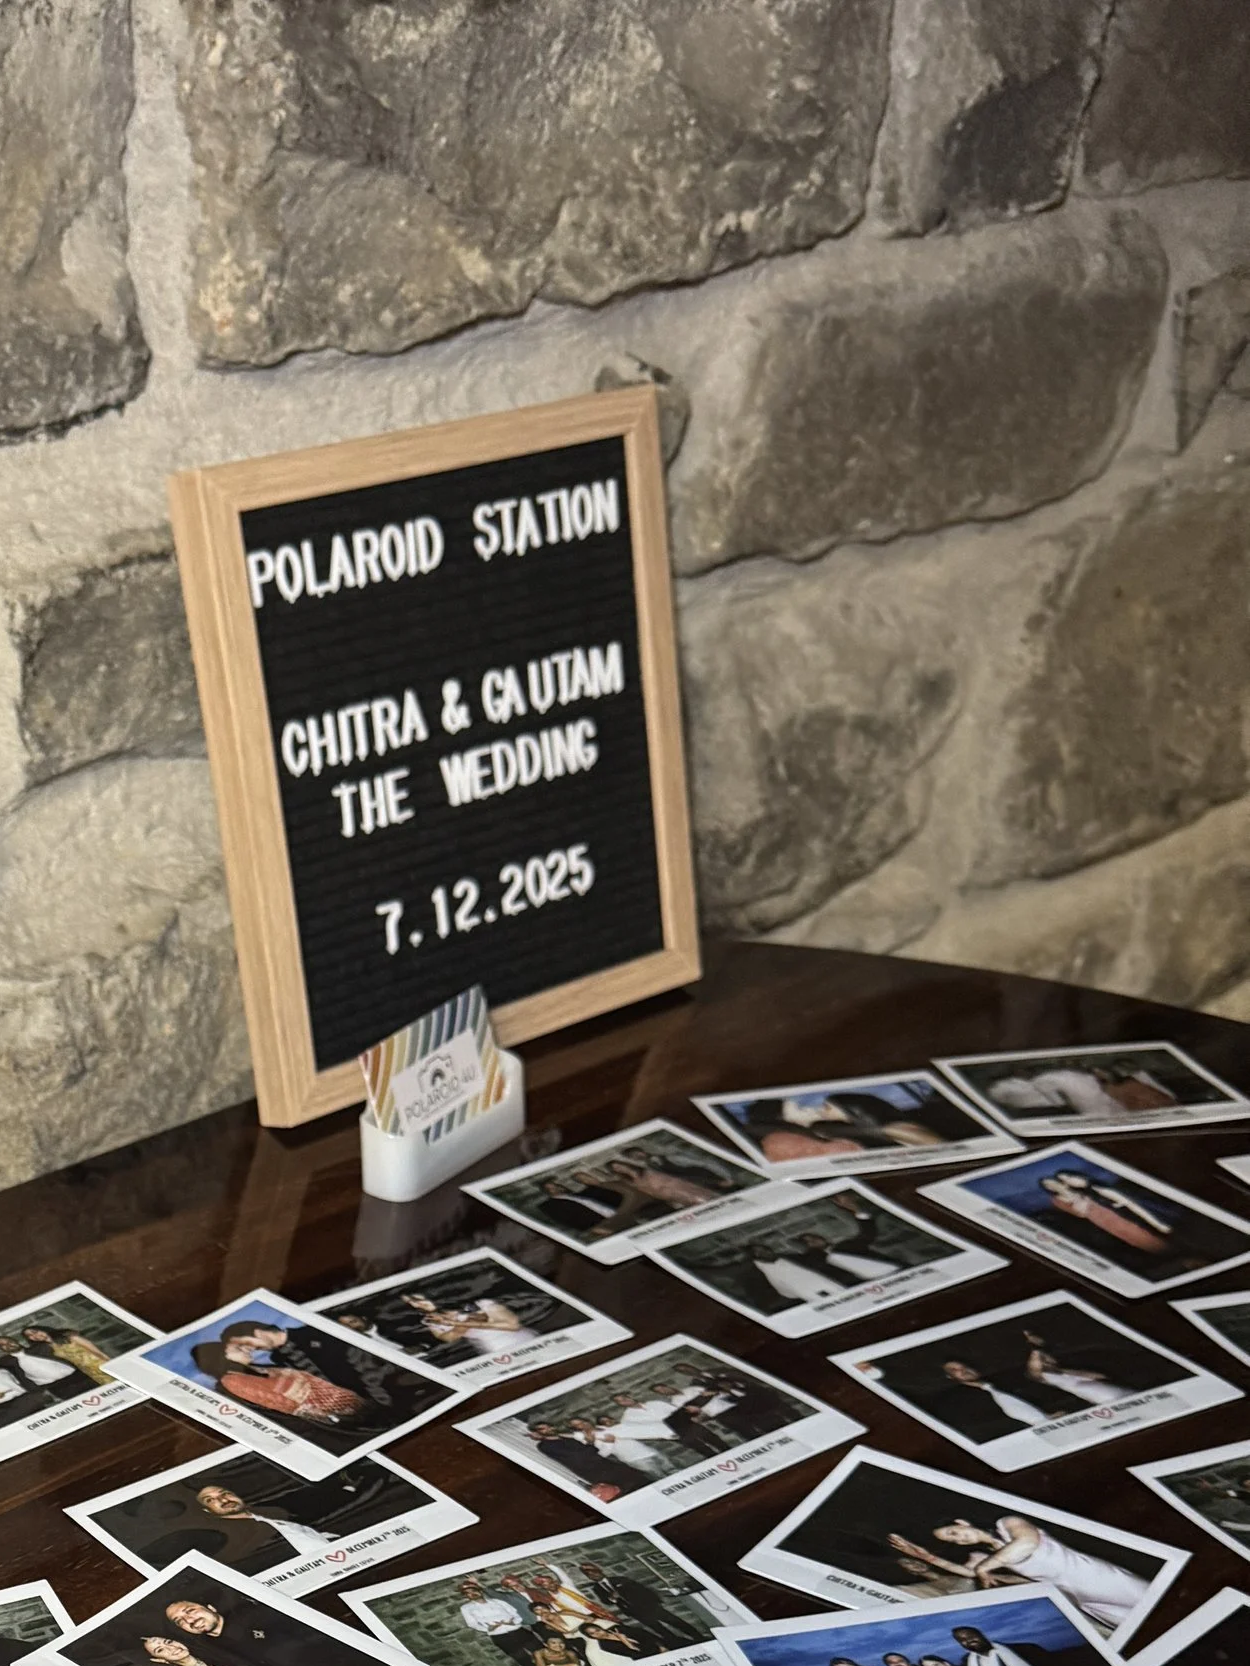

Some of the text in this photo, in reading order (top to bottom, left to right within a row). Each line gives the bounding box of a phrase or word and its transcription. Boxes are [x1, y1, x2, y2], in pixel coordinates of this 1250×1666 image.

[246, 477, 621, 608] POLAROID STATION
[281, 640, 624, 777] CHITRA & GAUTAM
[331, 717, 598, 838] THE WEDDING
[375, 842, 595, 955] 7.12.2025
